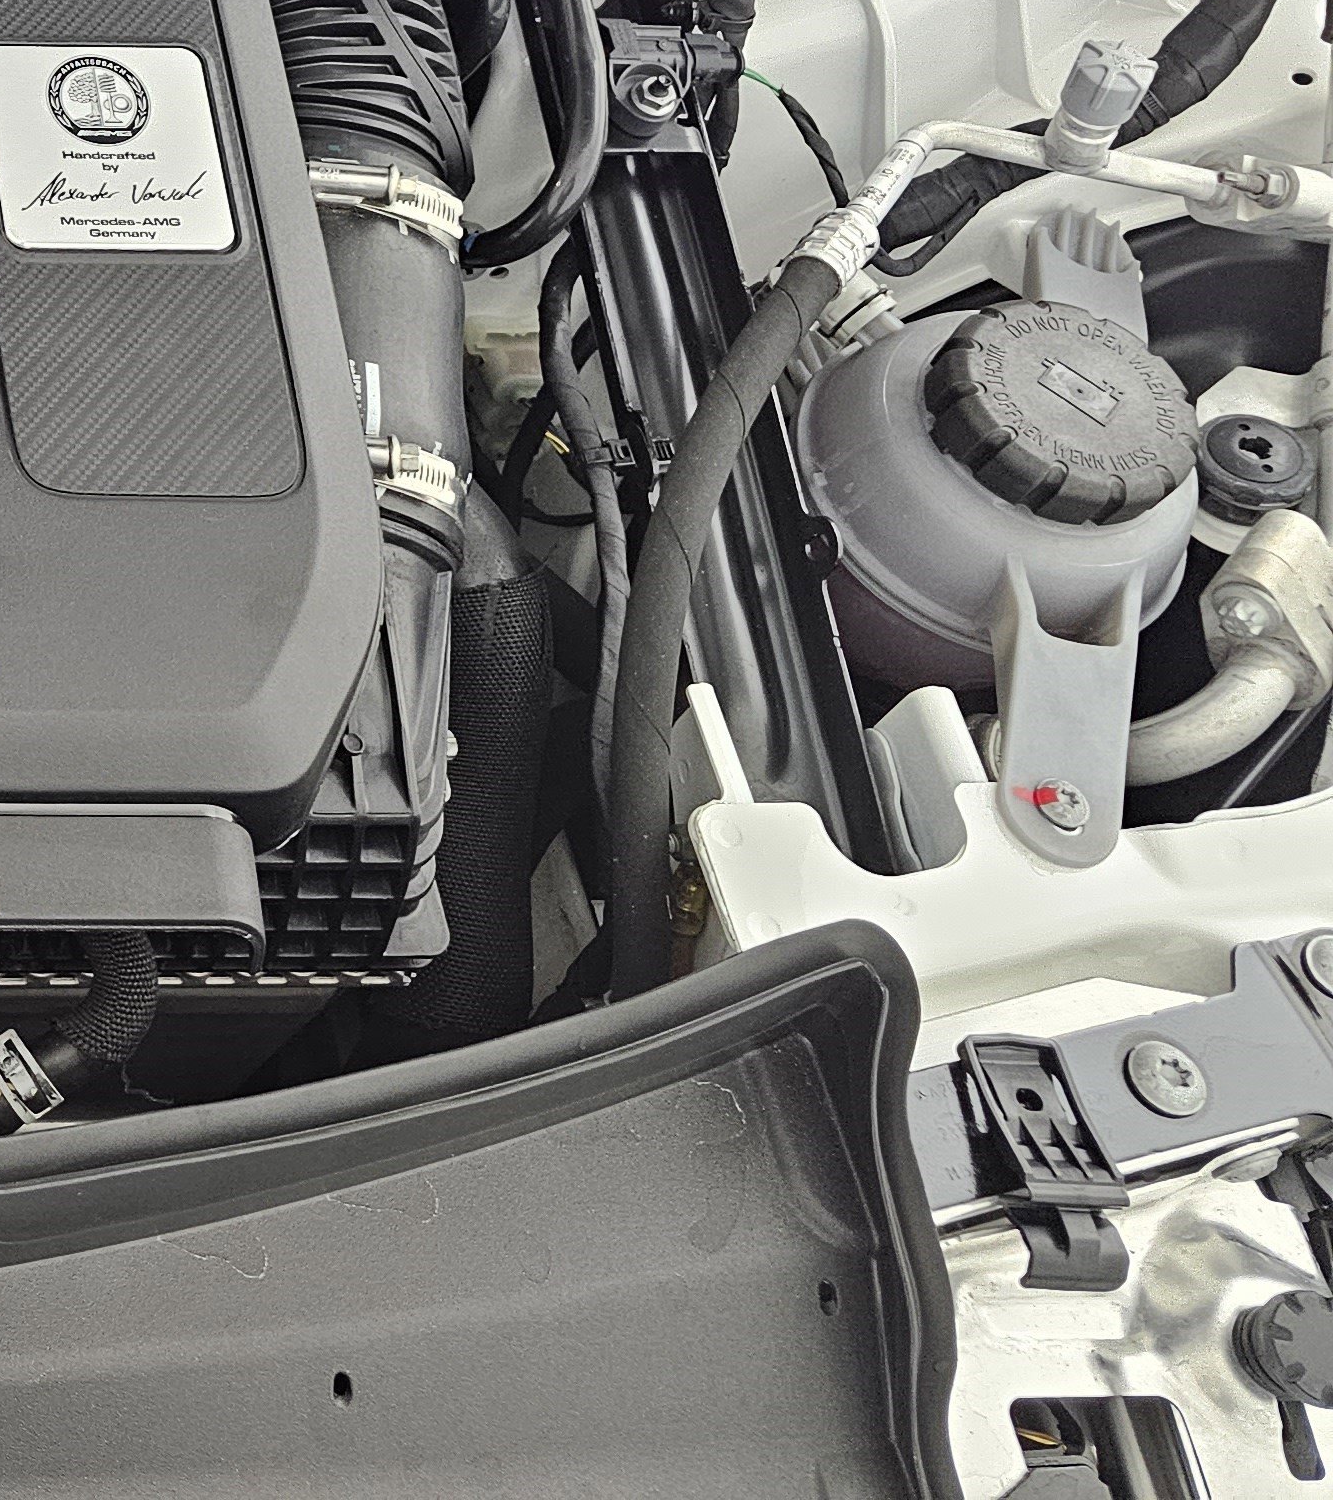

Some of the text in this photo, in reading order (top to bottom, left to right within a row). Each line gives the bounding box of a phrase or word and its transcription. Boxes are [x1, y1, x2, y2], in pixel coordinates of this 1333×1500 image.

[62, 150, 156, 161] Handcrafted
[101, 162, 120, 173] by
[21, 171, 120, 211] Alexander
[59, 216, 182, 228] Mercedes-AMG
[89, 228, 157, 240] Germany
[1004, 315, 1178, 440] DO NOT OPEN WHEN HOT
[1052, 440, 1107, 471] WENN
